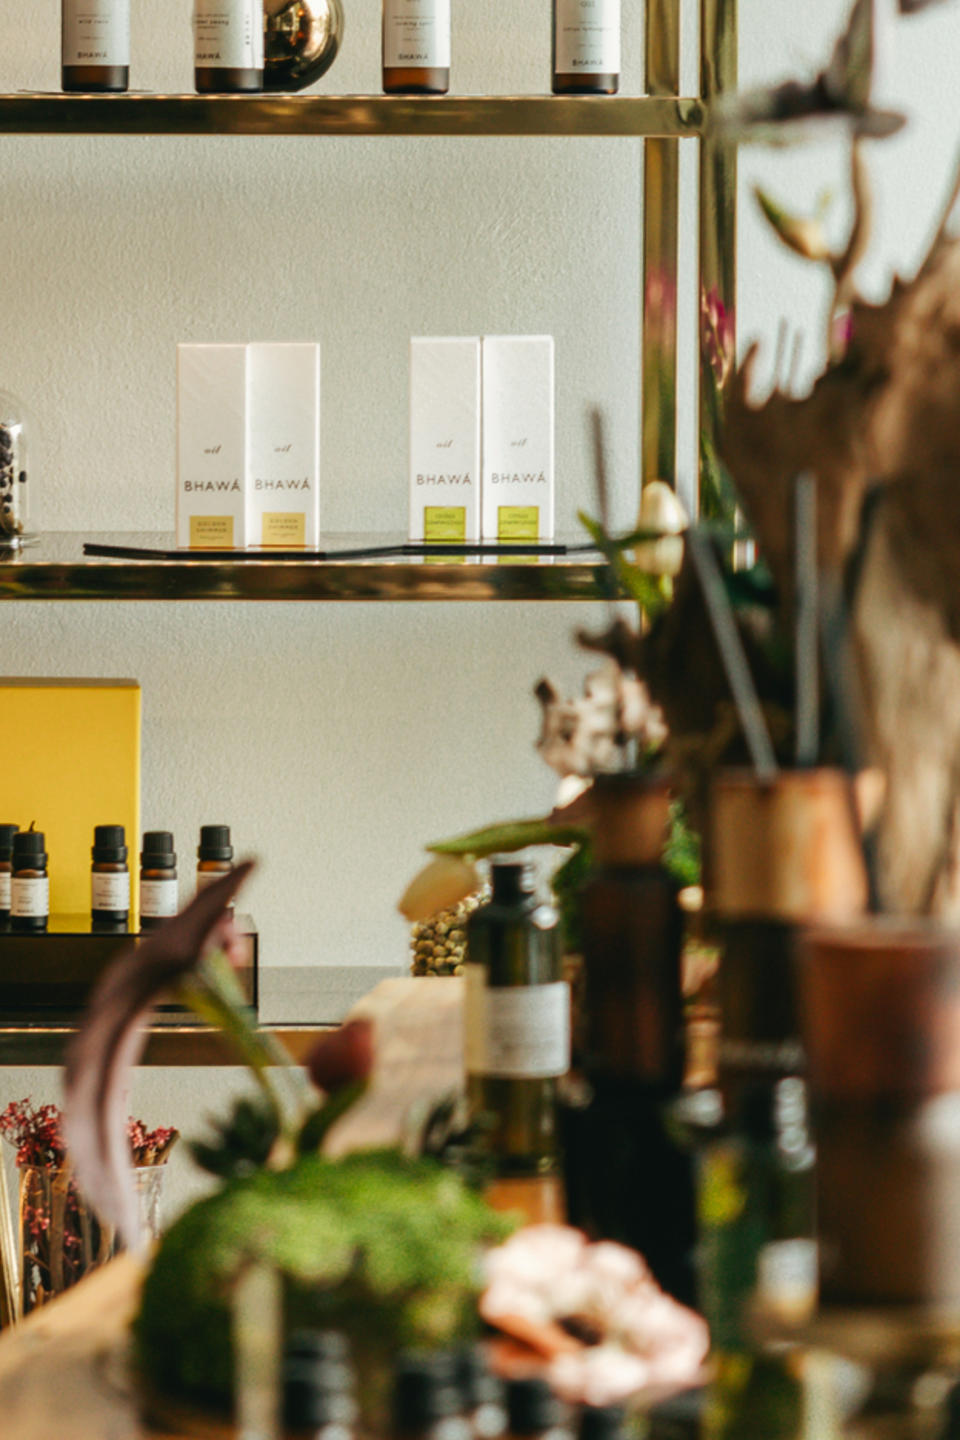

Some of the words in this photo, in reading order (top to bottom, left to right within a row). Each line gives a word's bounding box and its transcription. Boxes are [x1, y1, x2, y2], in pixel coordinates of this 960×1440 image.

[254, 477, 311, 491] BHAWÁ
[416, 472, 472, 485] BHAWÁ
[491, 471, 547, 484] BHAWÁ
[183, 478, 241, 492] BHAWÁ
